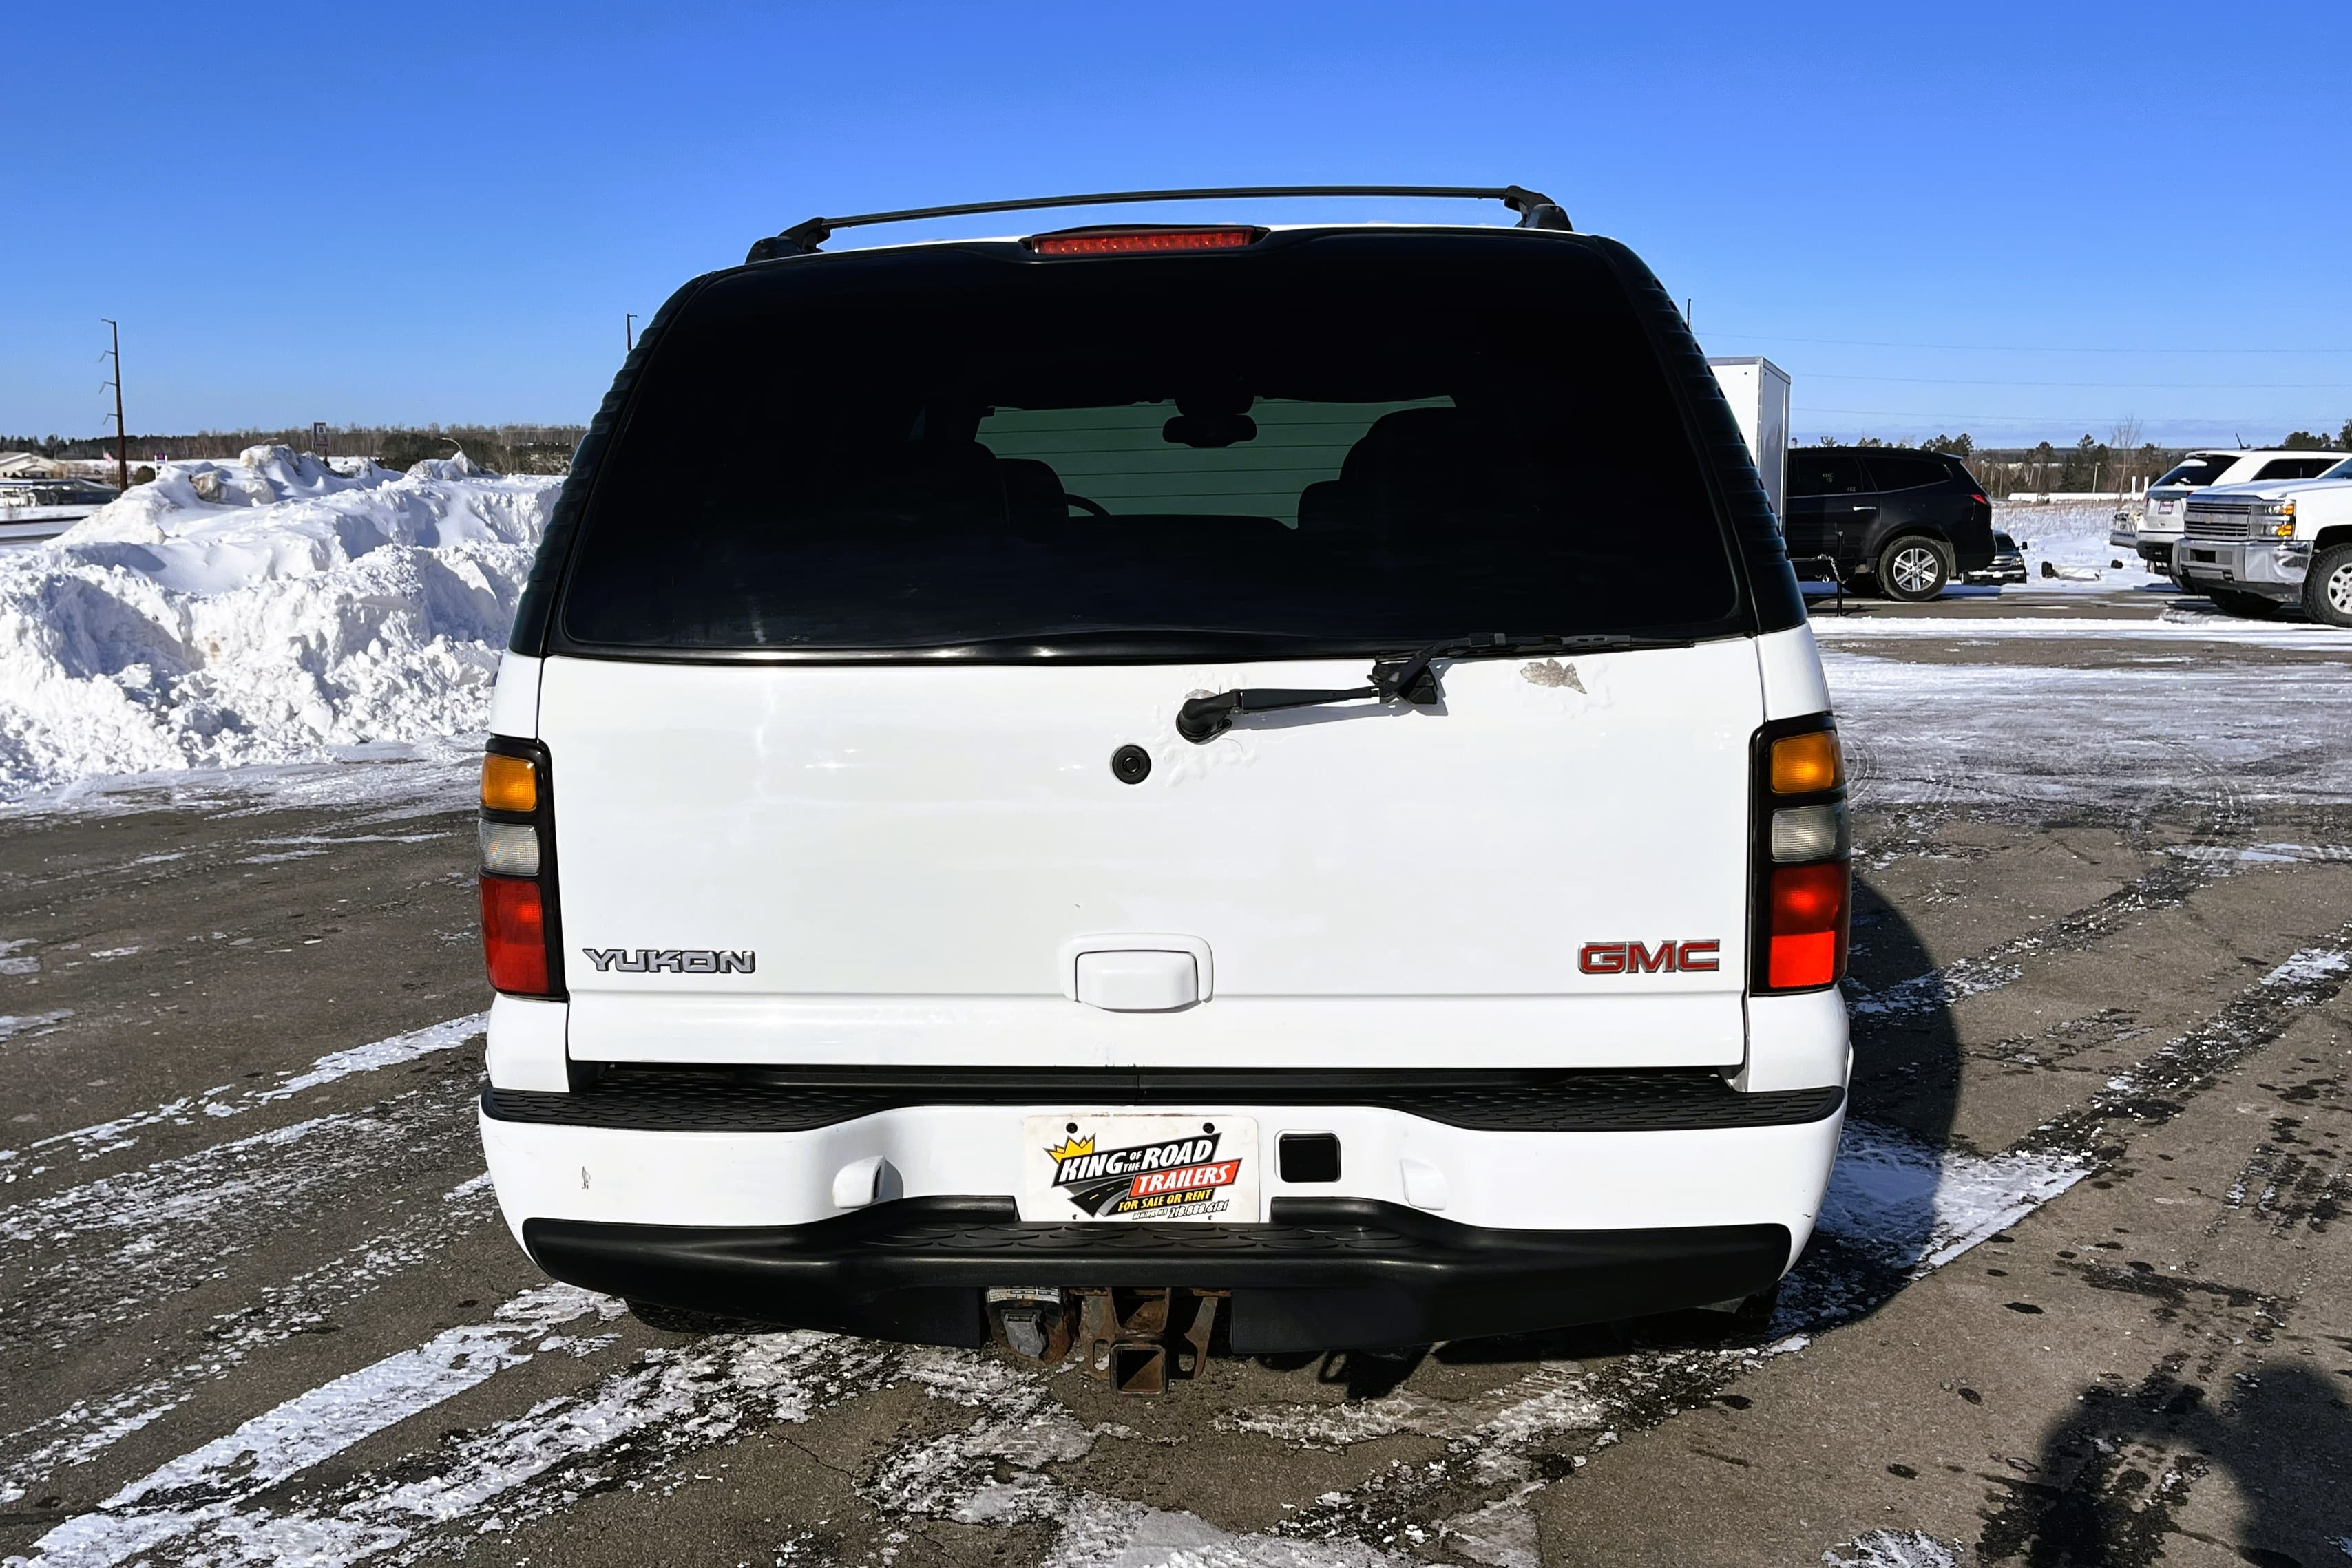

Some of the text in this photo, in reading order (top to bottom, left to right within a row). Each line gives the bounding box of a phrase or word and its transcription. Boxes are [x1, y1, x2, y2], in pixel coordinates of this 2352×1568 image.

[582, 948, 755, 973] YUKON
[1577, 939, 1720, 974] GMC
[1059, 1140, 1213, 1182] KING OF THE ROAD
[1138, 1164, 1231, 1194] TRAILERS
[1118, 1189, 1212, 1211] FOR SALE OR RENT
